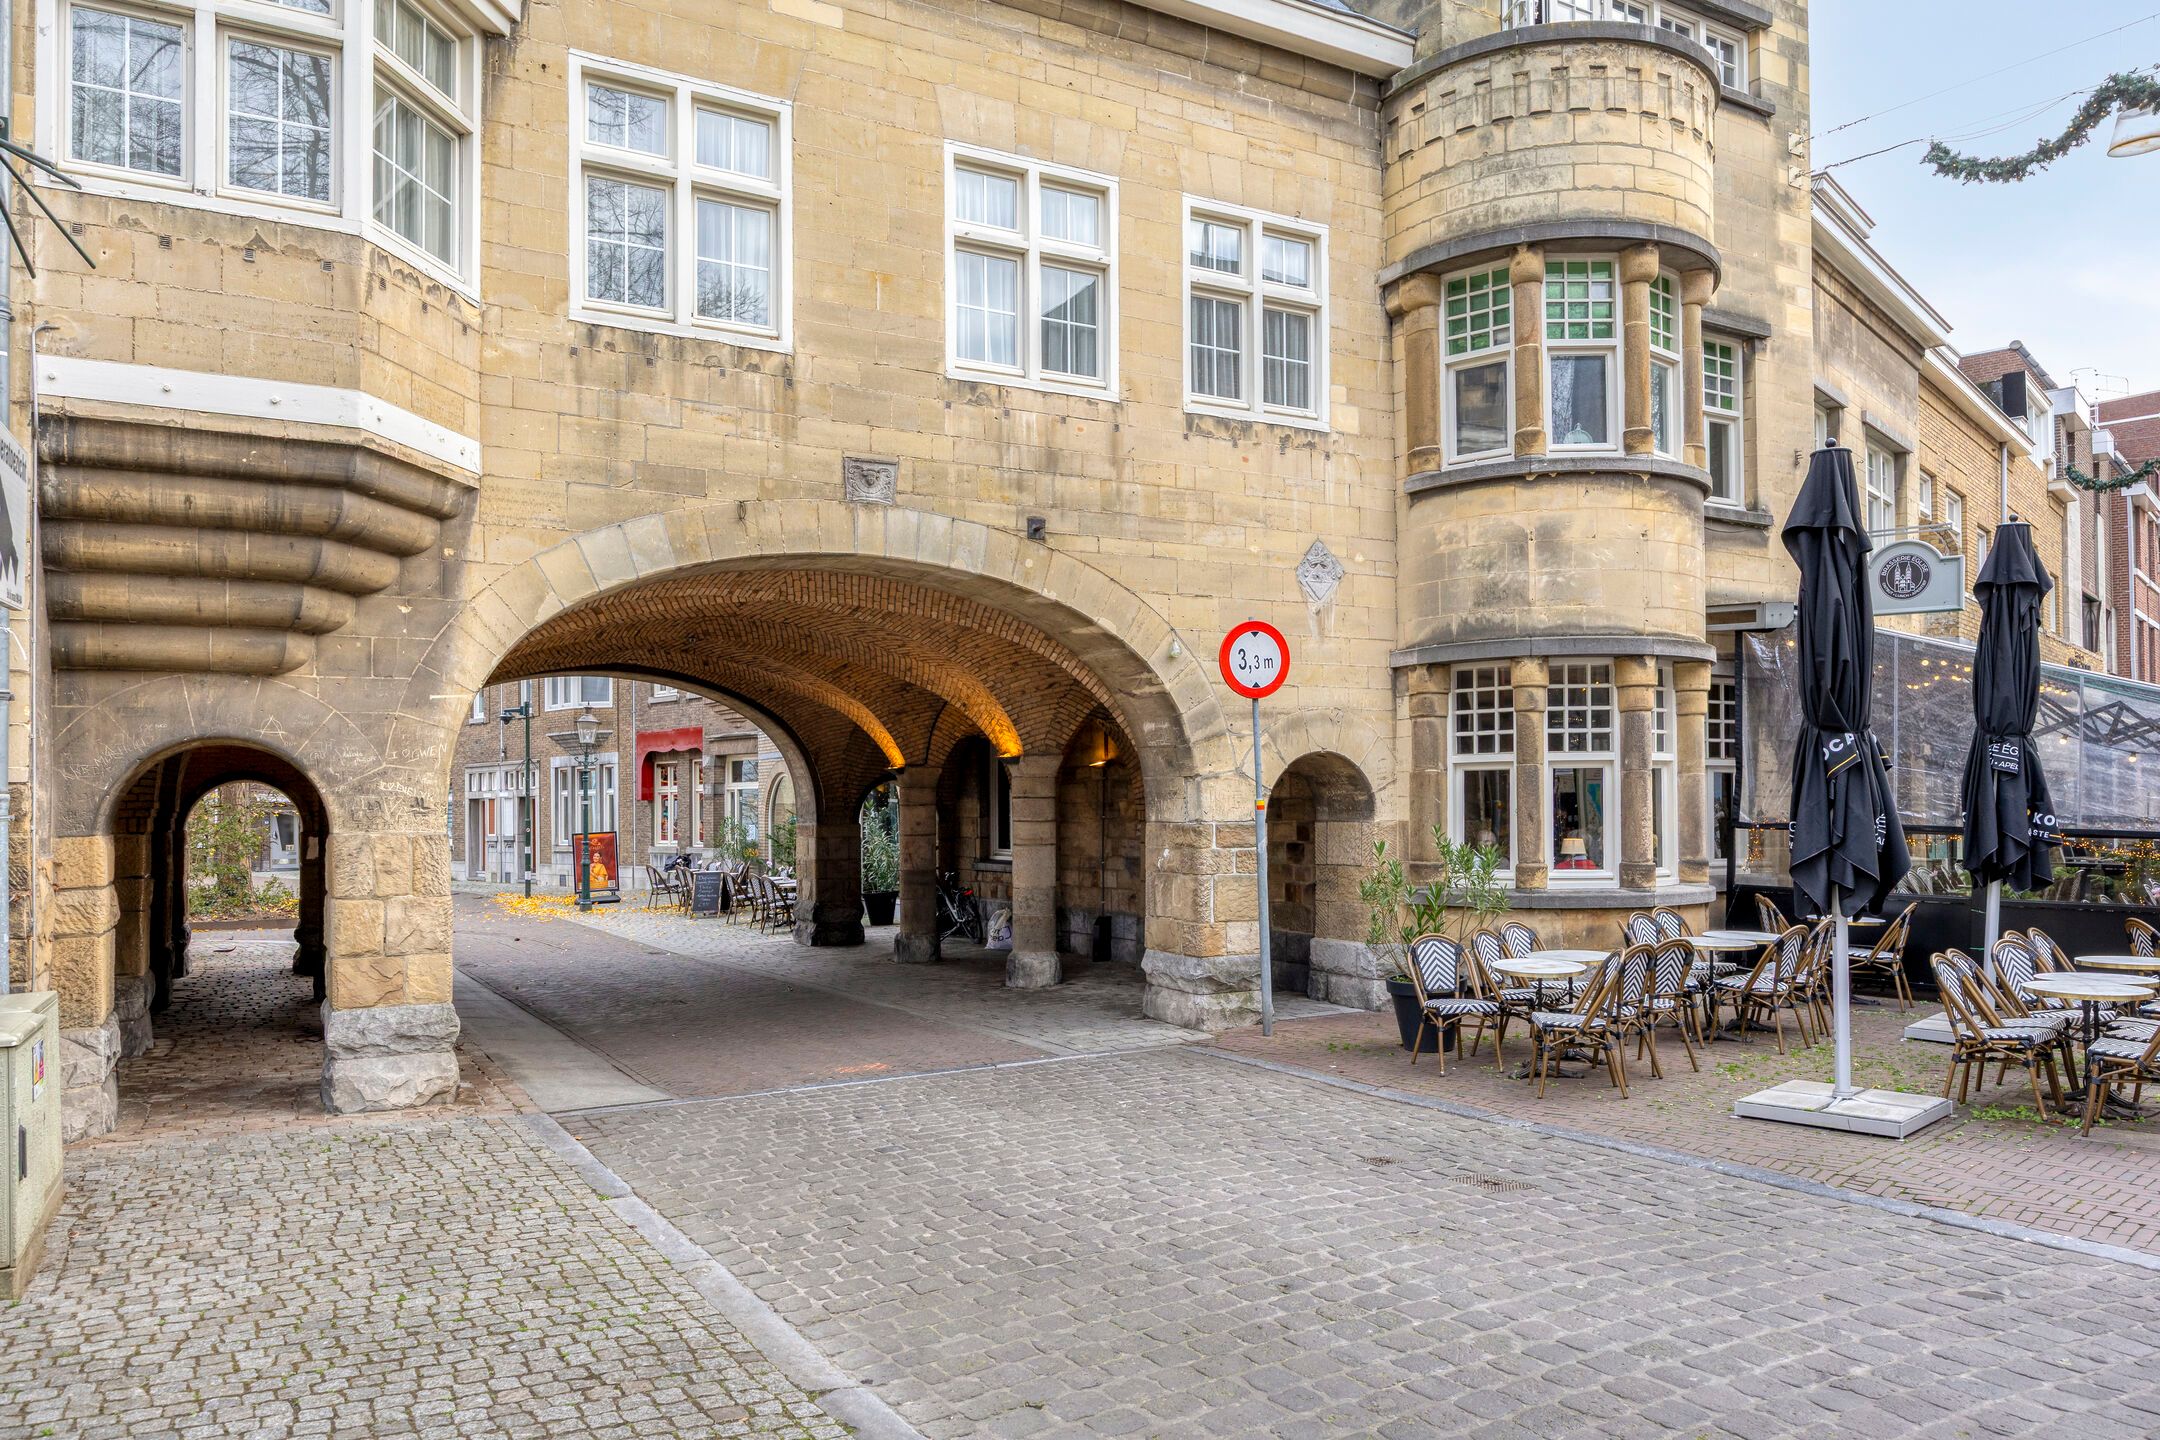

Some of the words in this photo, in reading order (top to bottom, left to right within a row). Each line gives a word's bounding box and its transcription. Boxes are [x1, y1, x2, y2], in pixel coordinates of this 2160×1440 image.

[1881, 556, 1911, 576] BRASSERIE
[1238, 648, 1260, 674] 3,3
[1263, 657, 1274, 669] m
